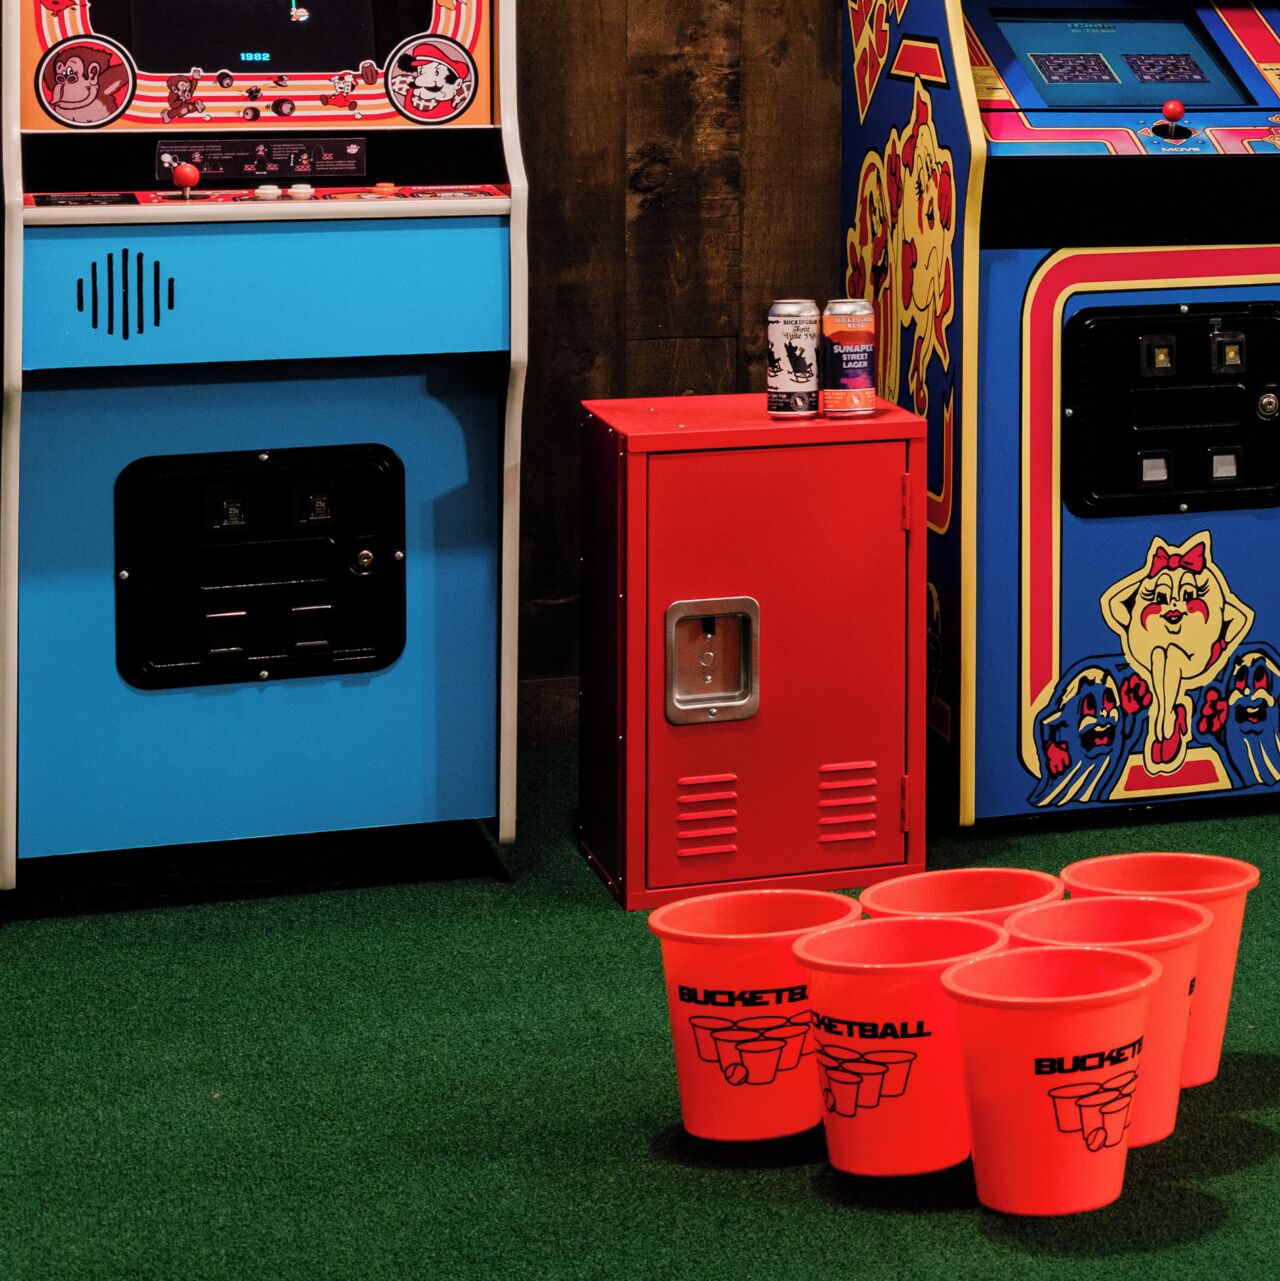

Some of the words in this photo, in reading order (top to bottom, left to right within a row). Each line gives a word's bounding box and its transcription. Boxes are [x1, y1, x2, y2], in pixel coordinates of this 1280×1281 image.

[240, 53, 270, 61] 1982
[842, 353, 868, 361] STREET
[678, 985, 808, 1007] BUCKETB
